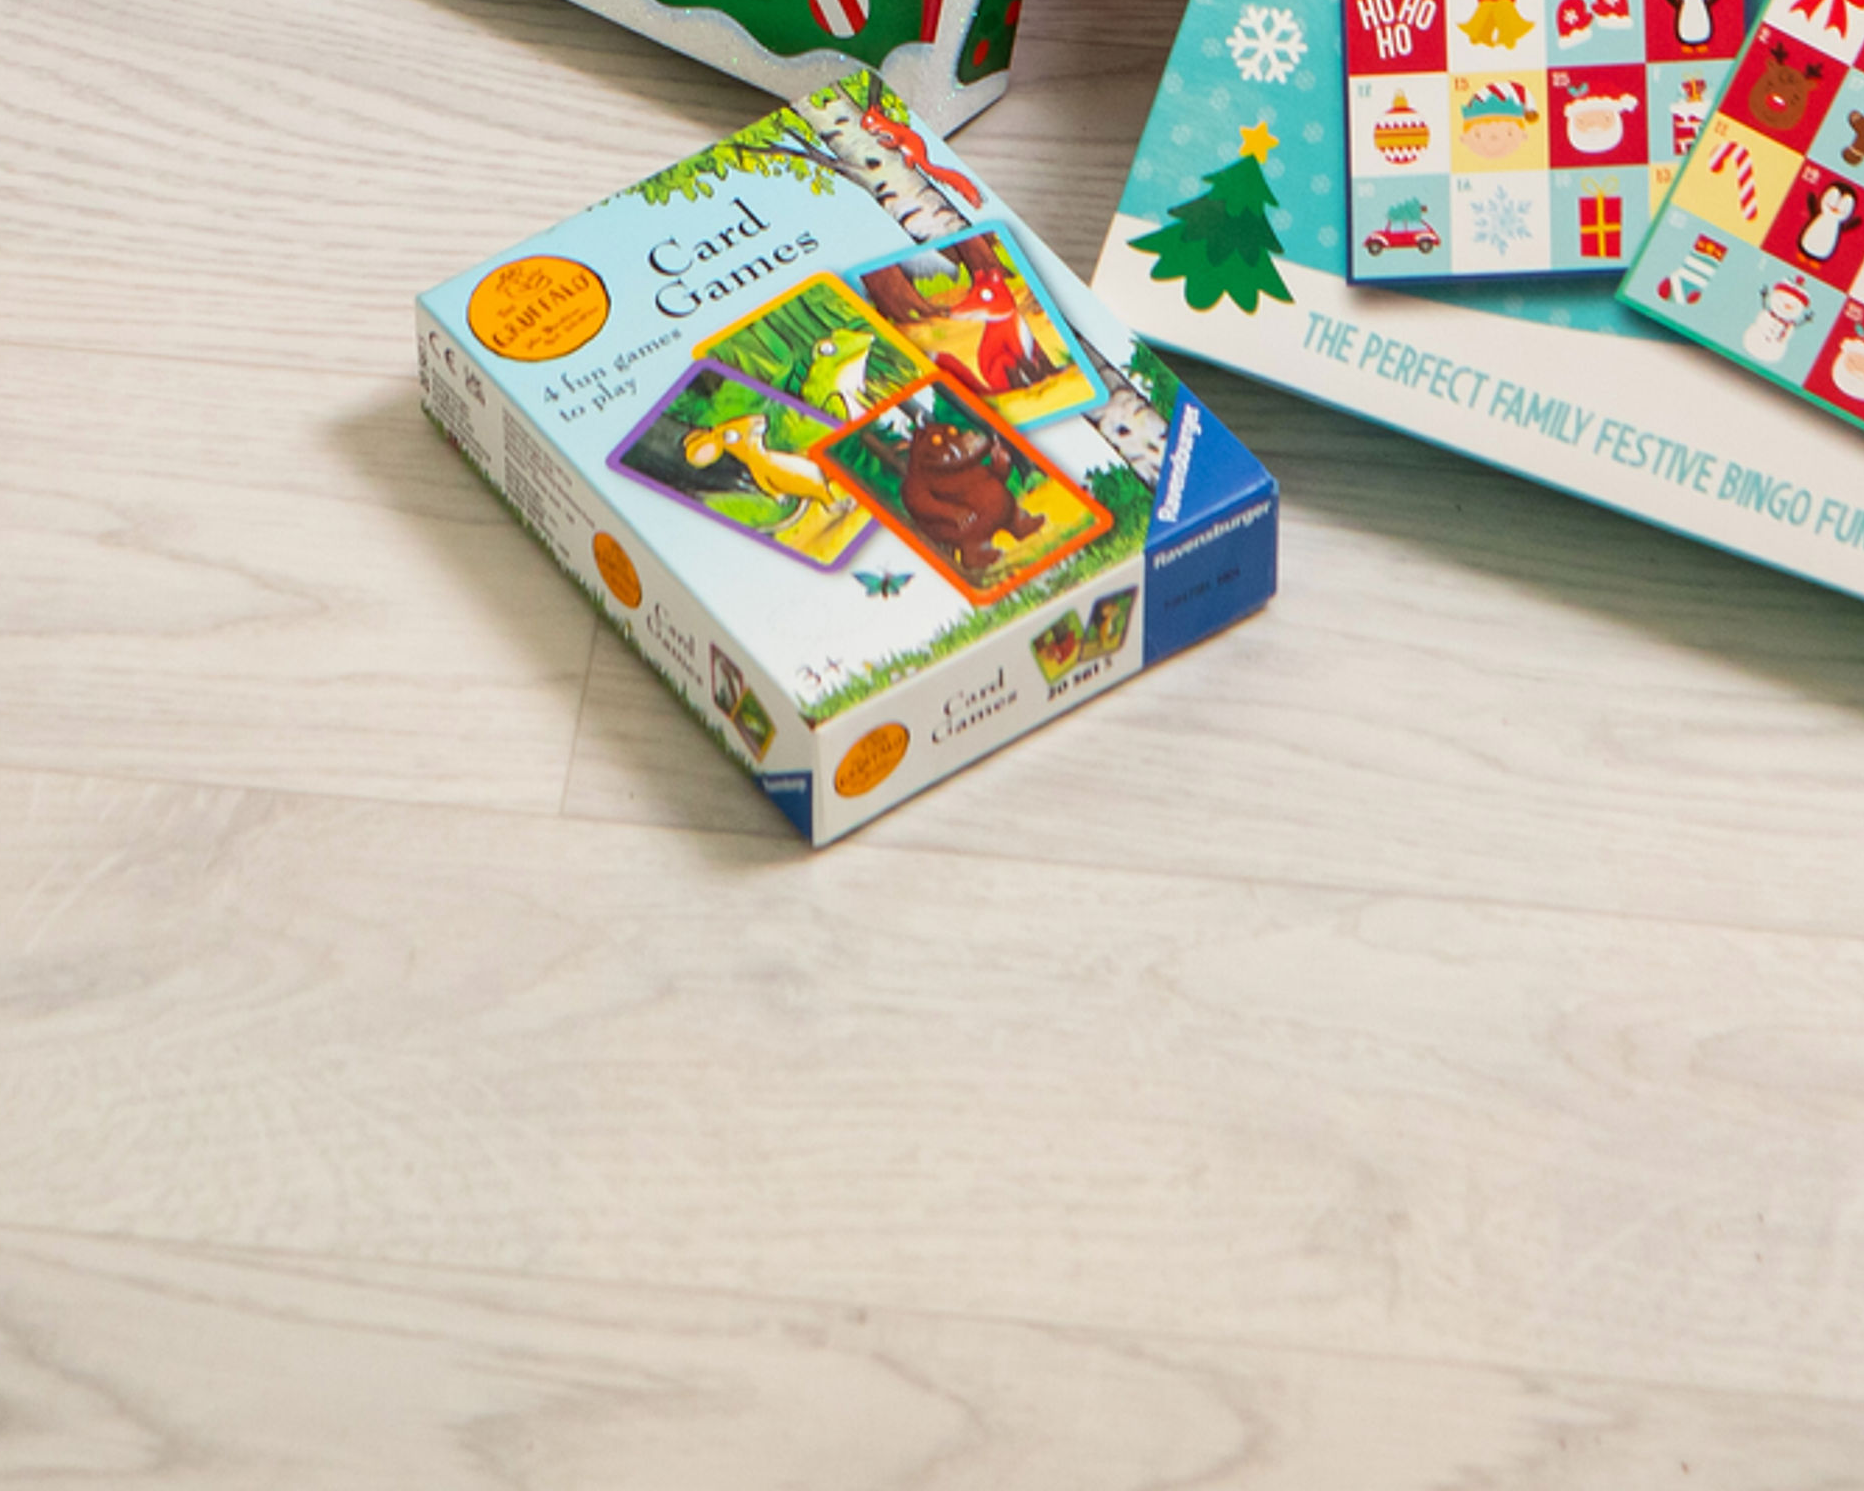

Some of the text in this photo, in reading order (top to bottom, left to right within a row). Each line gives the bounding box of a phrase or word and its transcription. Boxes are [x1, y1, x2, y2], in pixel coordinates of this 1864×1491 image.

[1375, 22, 1414, 60] HO
[647, 196, 771, 277] Card
[654, 229, 821, 319] Games
[543, 384, 560, 405] 4
[560, 365, 608, 395] fun
[613, 327, 683, 372] games
[558, 376, 639, 423] to play
[1302, 310, 1359, 365] THE
[1358, 330, 1491, 410] PERFECT
[1487, 377, 1596, 447] FAMILY
[1593, 417, 1718, 495] FESTIVE
[1716, 459, 1813, 528] BINGO
[1152, 498, 1273, 571] Ravensburger
[931, 690, 1018, 745] Games
[943, 666, 1005, 718] Card
